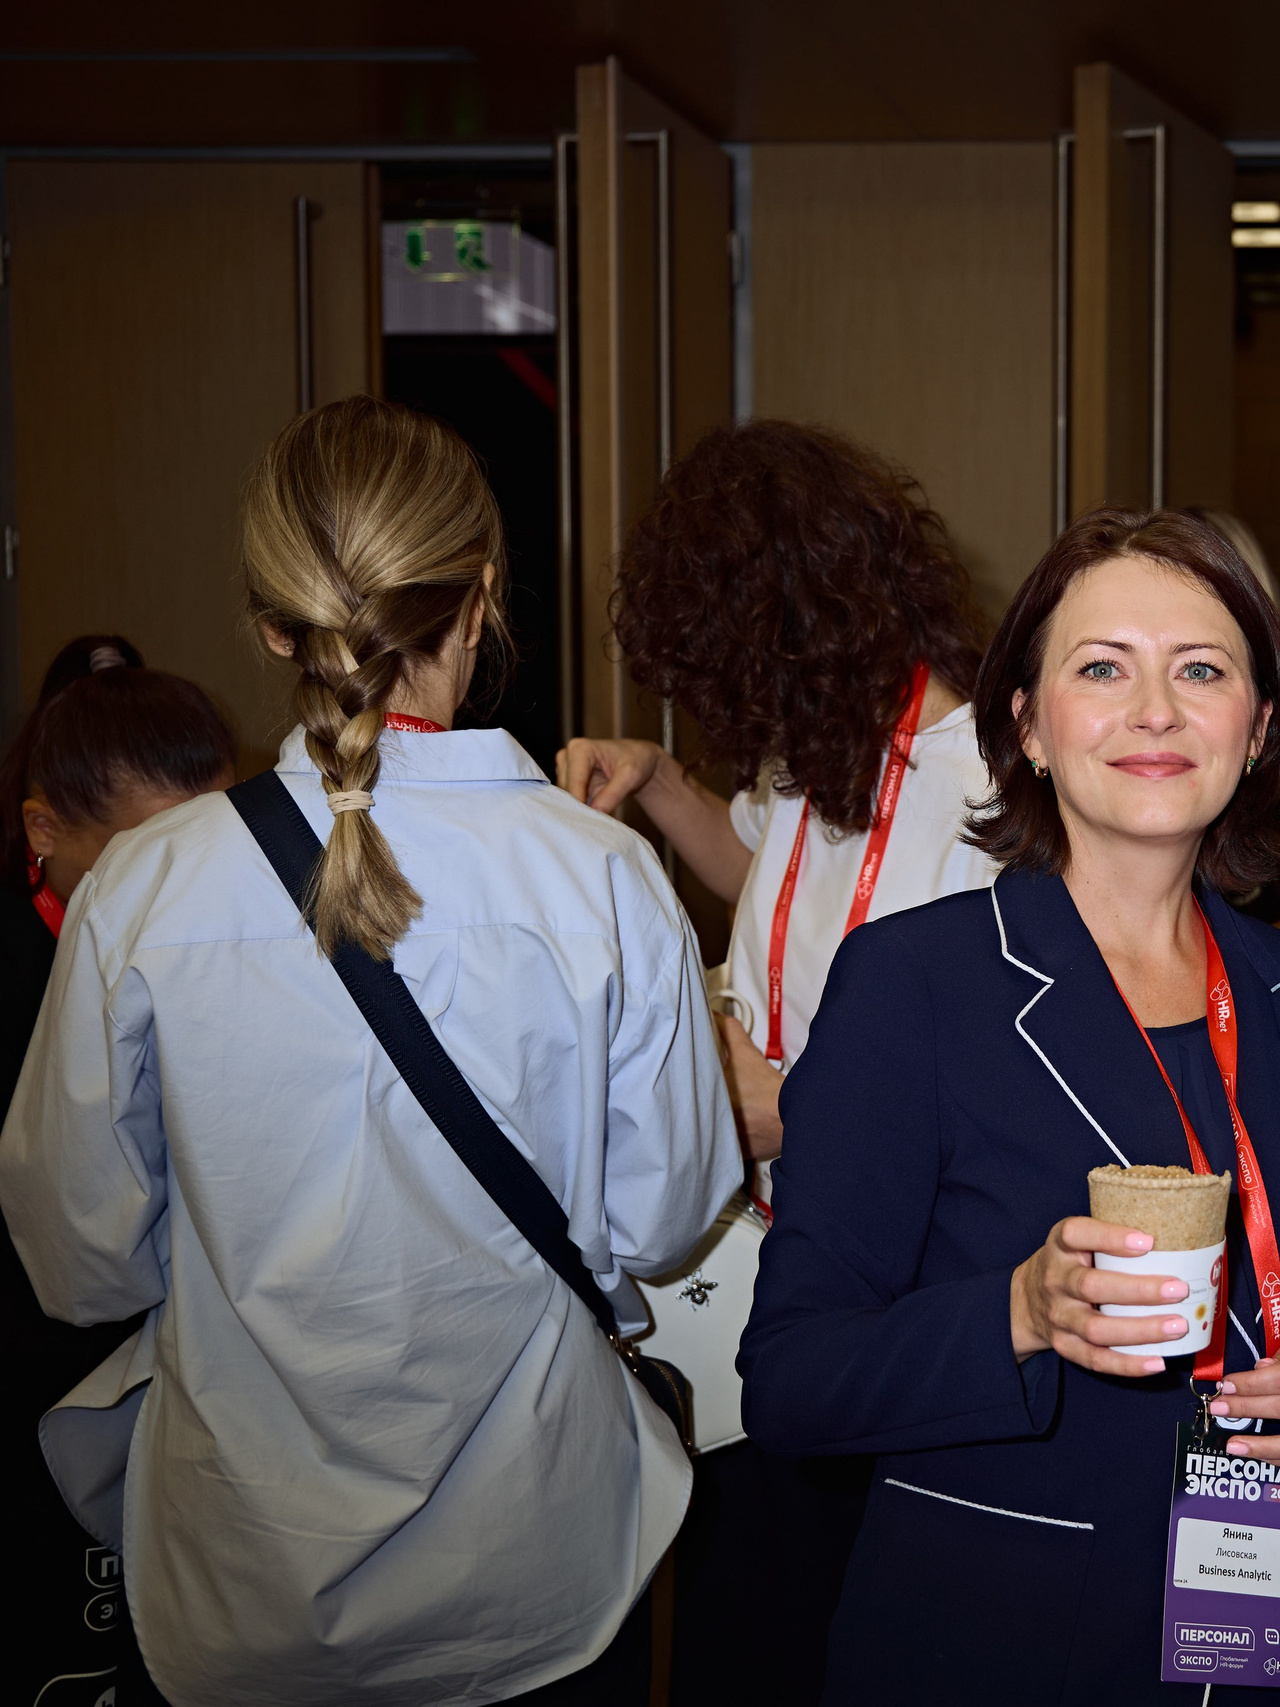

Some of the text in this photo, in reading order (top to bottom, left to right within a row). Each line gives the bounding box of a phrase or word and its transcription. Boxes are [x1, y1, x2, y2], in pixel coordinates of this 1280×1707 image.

[880, 764, 900, 819] ПЕРСОНАЛ
[1218, 1000, 1230, 1033] HRnet
[1238, 1152, 1252, 1184] ЭКСПО
[1184, 1473, 1261, 1501] ЭКСПО
[1222, 1528, 1253, 1541] Янина
[1215, 1547, 1257, 1560] Лисовская
[1198, 1564, 1272, 1582] Business Analytic
[1180, 1628, 1250, 1645] ПЕРСОНАЛ
[1179, 1655, 1212, 1665] ЭКСПО
[1219, 1655, 1249, 1663] Глобальный
